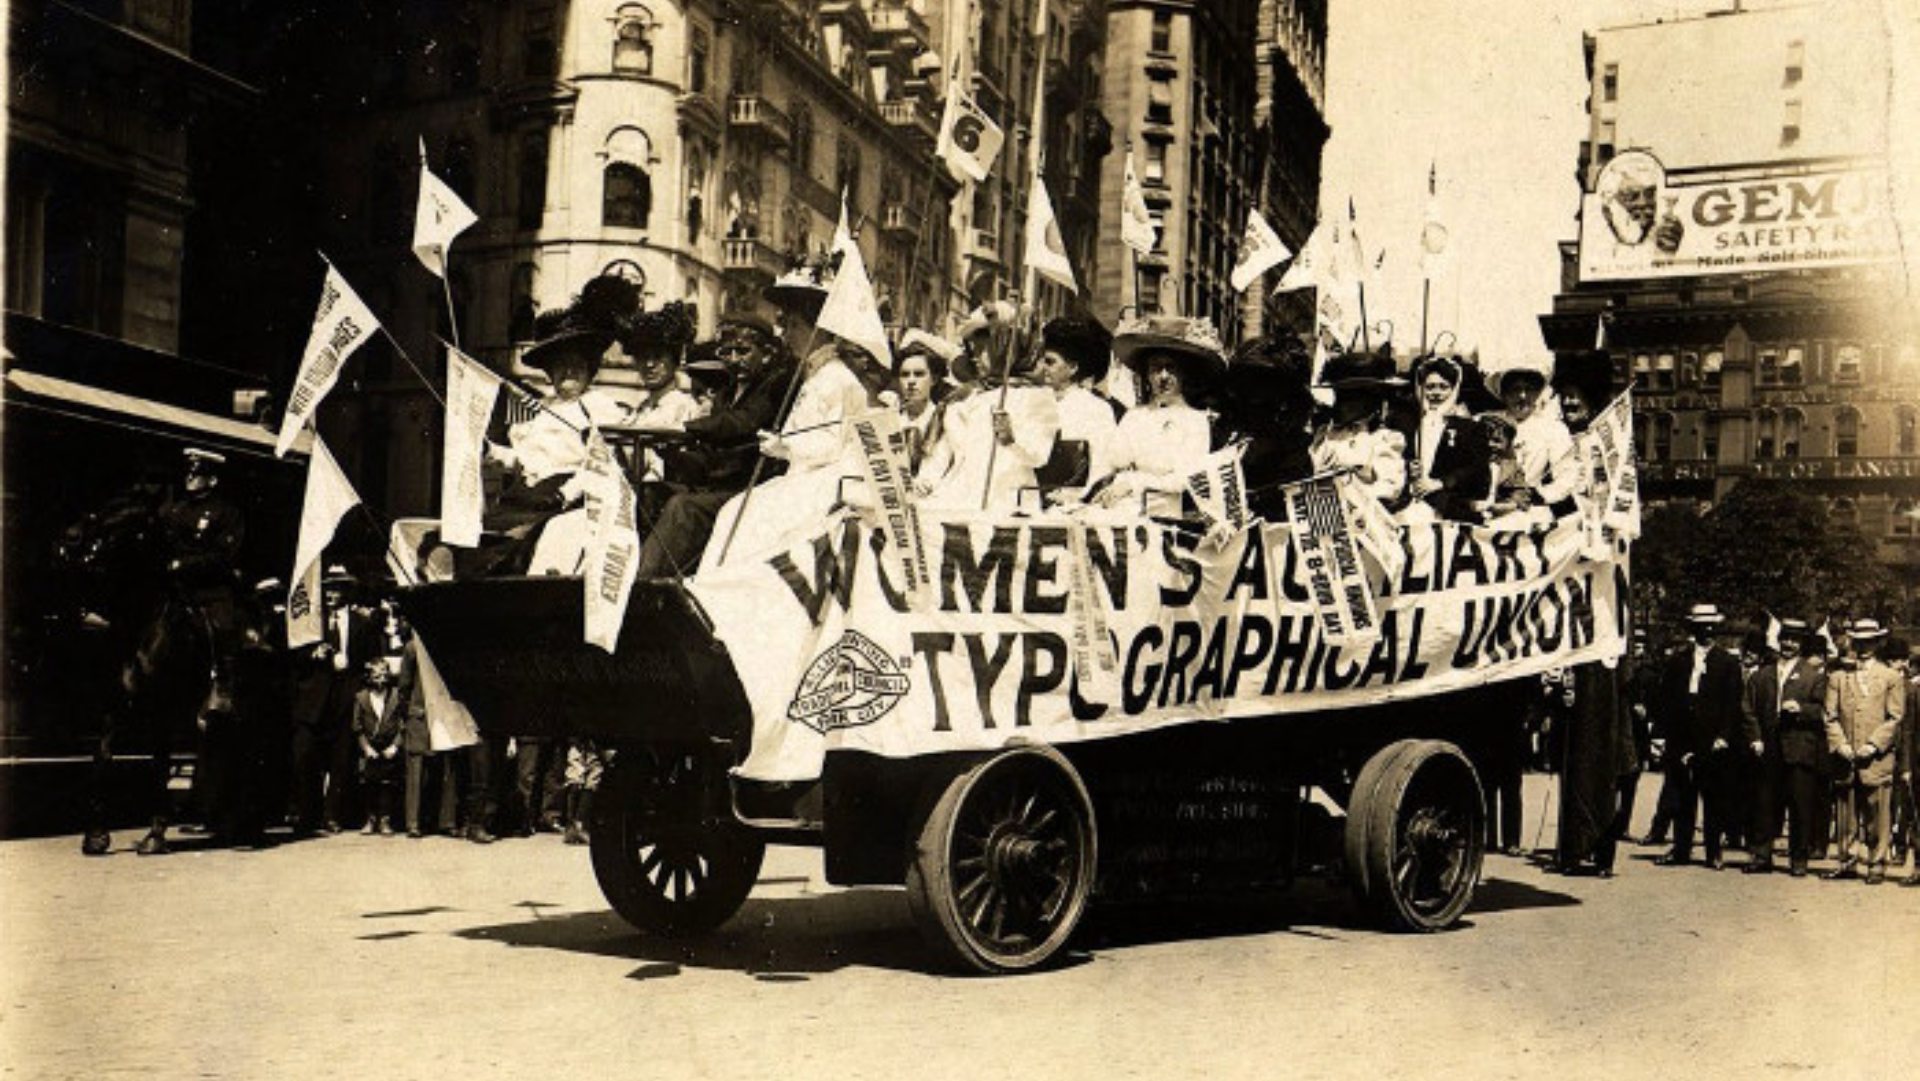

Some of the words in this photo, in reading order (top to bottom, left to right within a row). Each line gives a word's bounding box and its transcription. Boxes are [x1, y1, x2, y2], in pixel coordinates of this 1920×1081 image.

[953, 114, 985, 153] 6
[1691, 178, 1840, 227] GEM
[1715, 224, 1823, 249] SAFETY
[868, 459, 893, 483] PAY
[1789, 461, 1823, 479] OF
[600, 543, 632, 605] EQUAL
[1226, 520, 1557, 600] AULIARY
[1453, 572, 1594, 668] UNION
[857, 700, 885, 721] CITY
